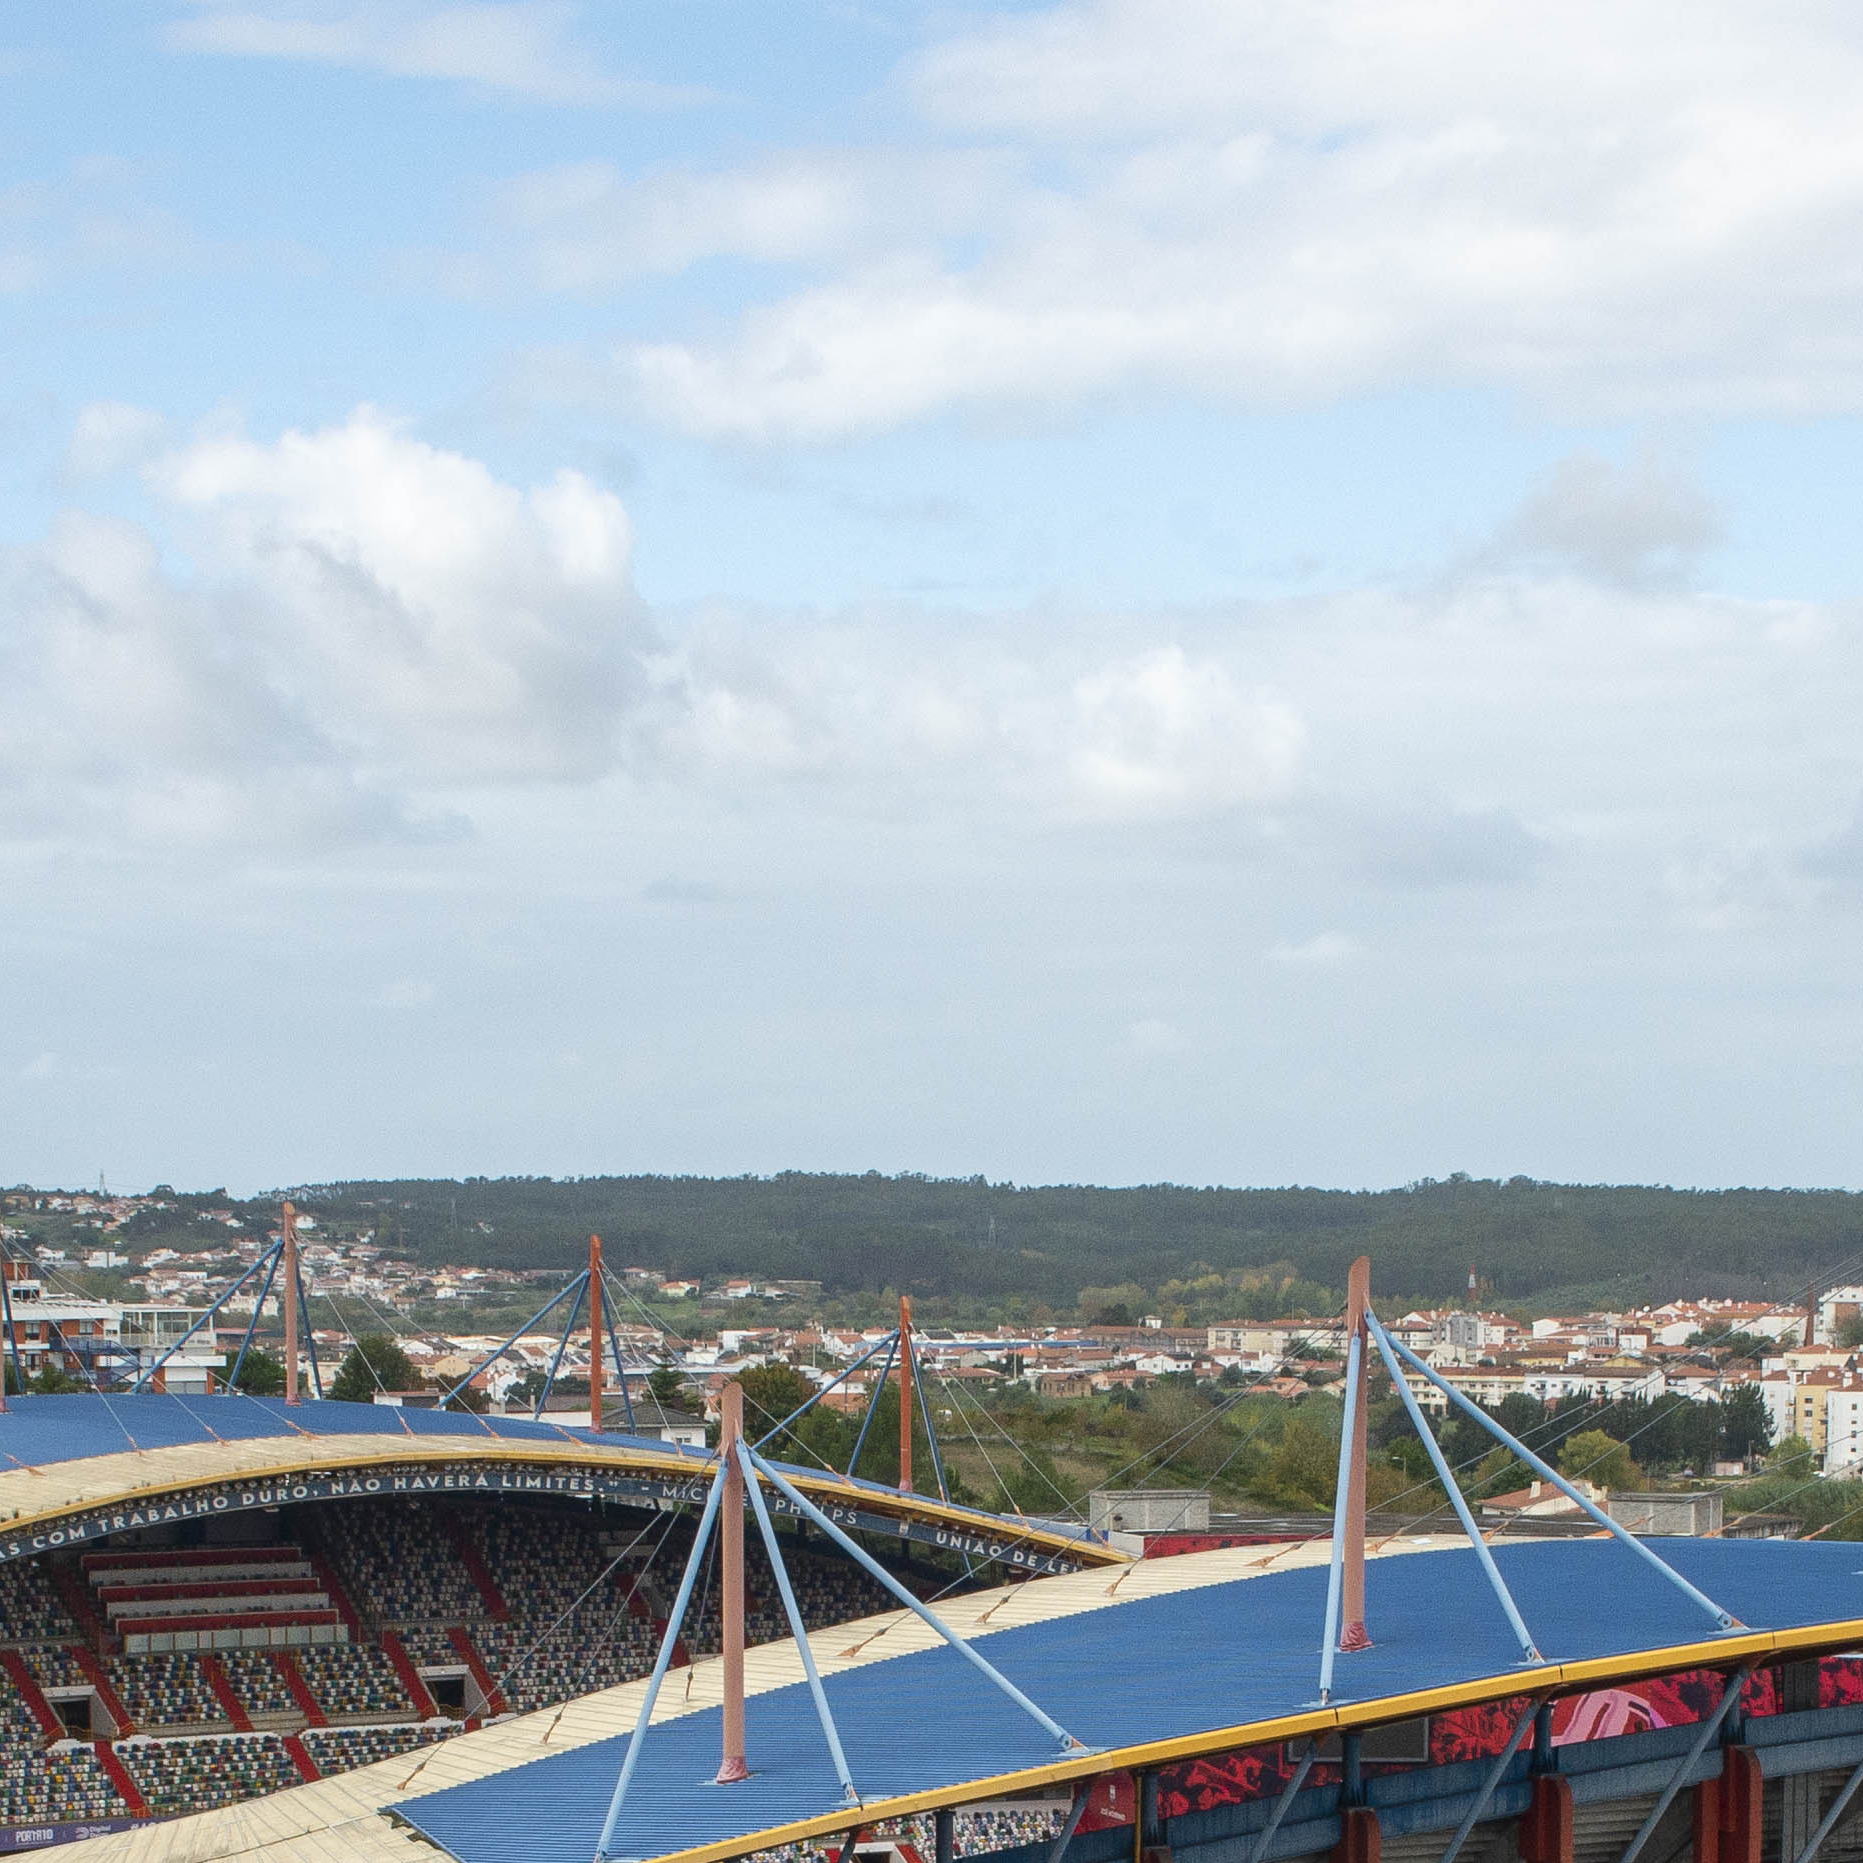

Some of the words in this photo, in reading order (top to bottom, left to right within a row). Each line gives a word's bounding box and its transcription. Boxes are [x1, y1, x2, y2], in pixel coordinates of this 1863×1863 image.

[32, 1525, 86, 1549] COM
[98, 1495, 229, 1533] TRABALHO
[242, 1485, 319, 1506] DURO,
[331, 1477, 381, 1495] NÃO
[394, 1474, 489, 1490] HAVERÁ
[936, 1531, 1002, 1557] UNIÃO
[1013, 1551, 1037, 1567] DE
